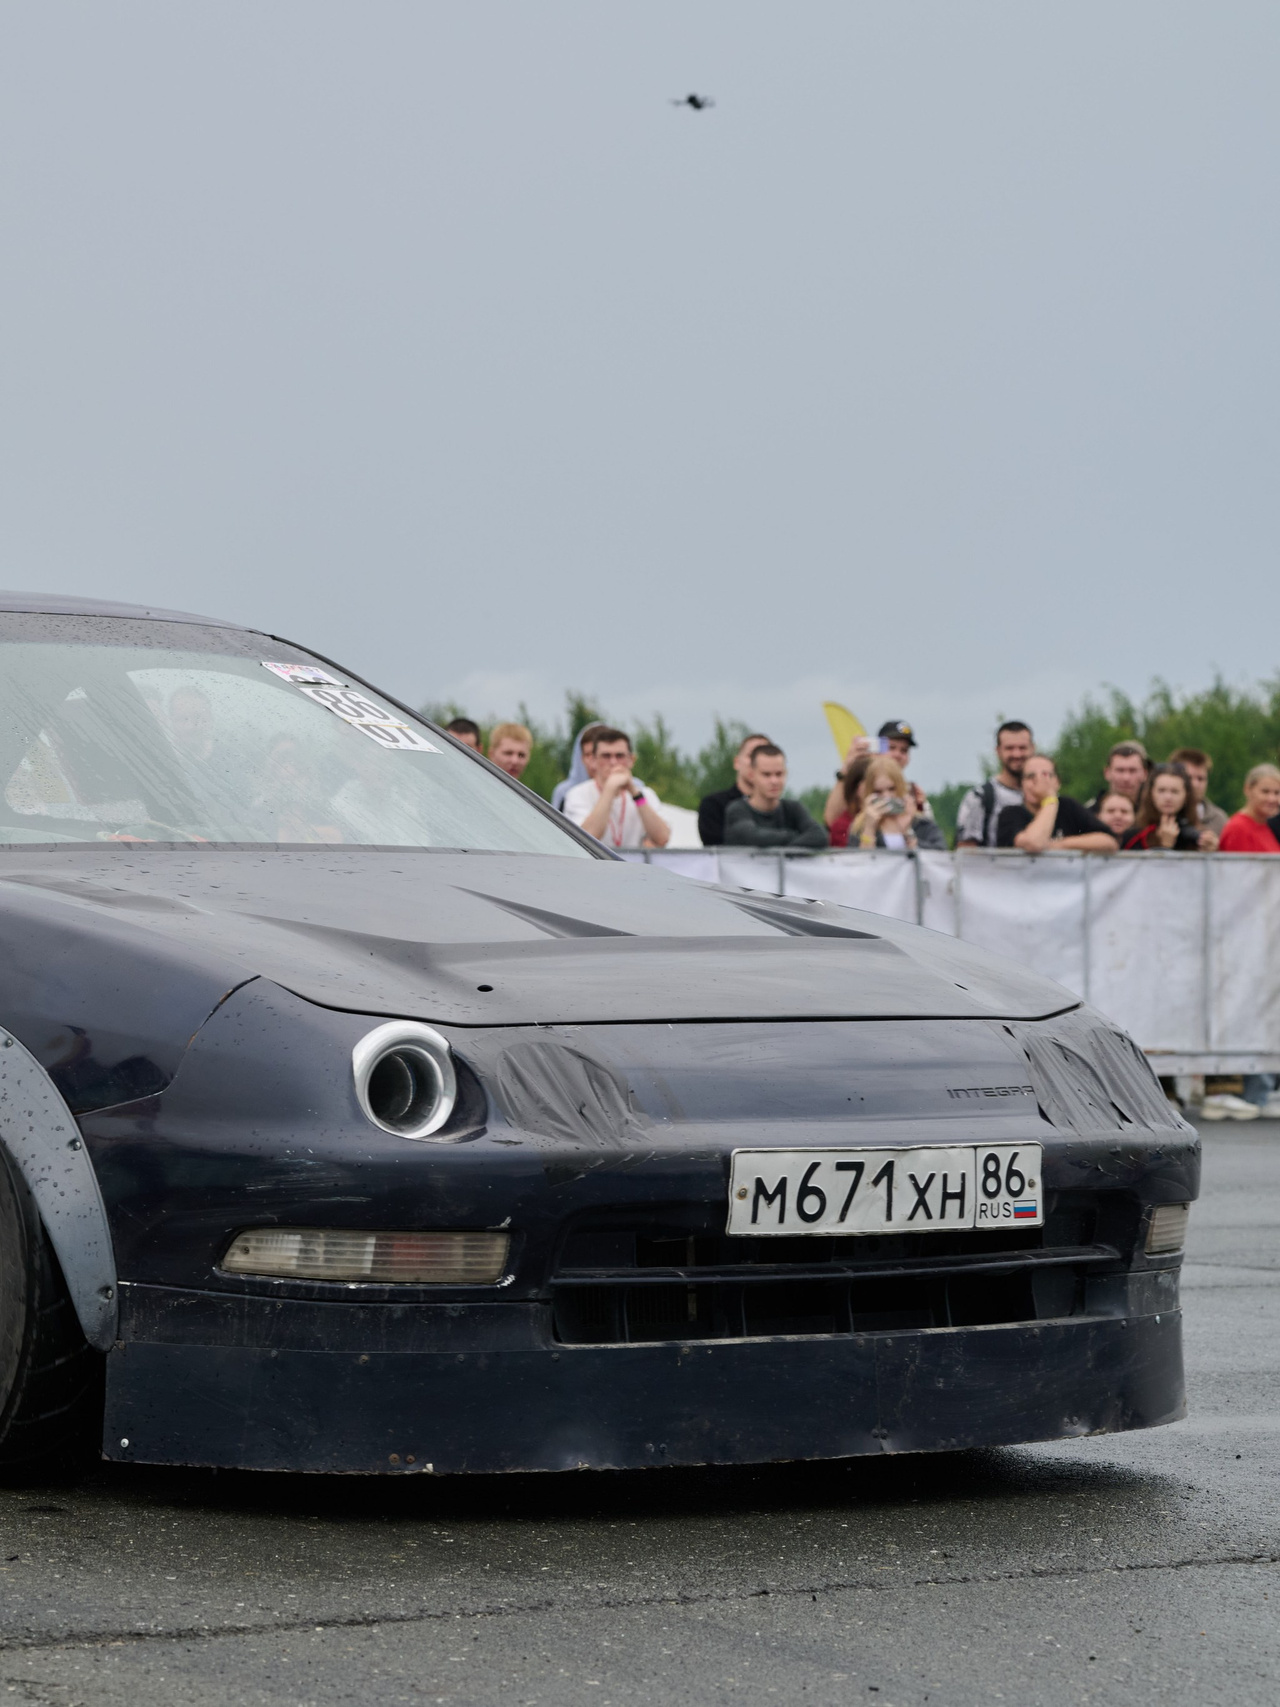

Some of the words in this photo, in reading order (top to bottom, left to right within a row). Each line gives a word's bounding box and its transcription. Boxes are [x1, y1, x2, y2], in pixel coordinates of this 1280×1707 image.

[312, 689, 390, 720] 86
[982, 1152, 1026, 1199] 86
[979, 1202, 1012, 1219] RUS
